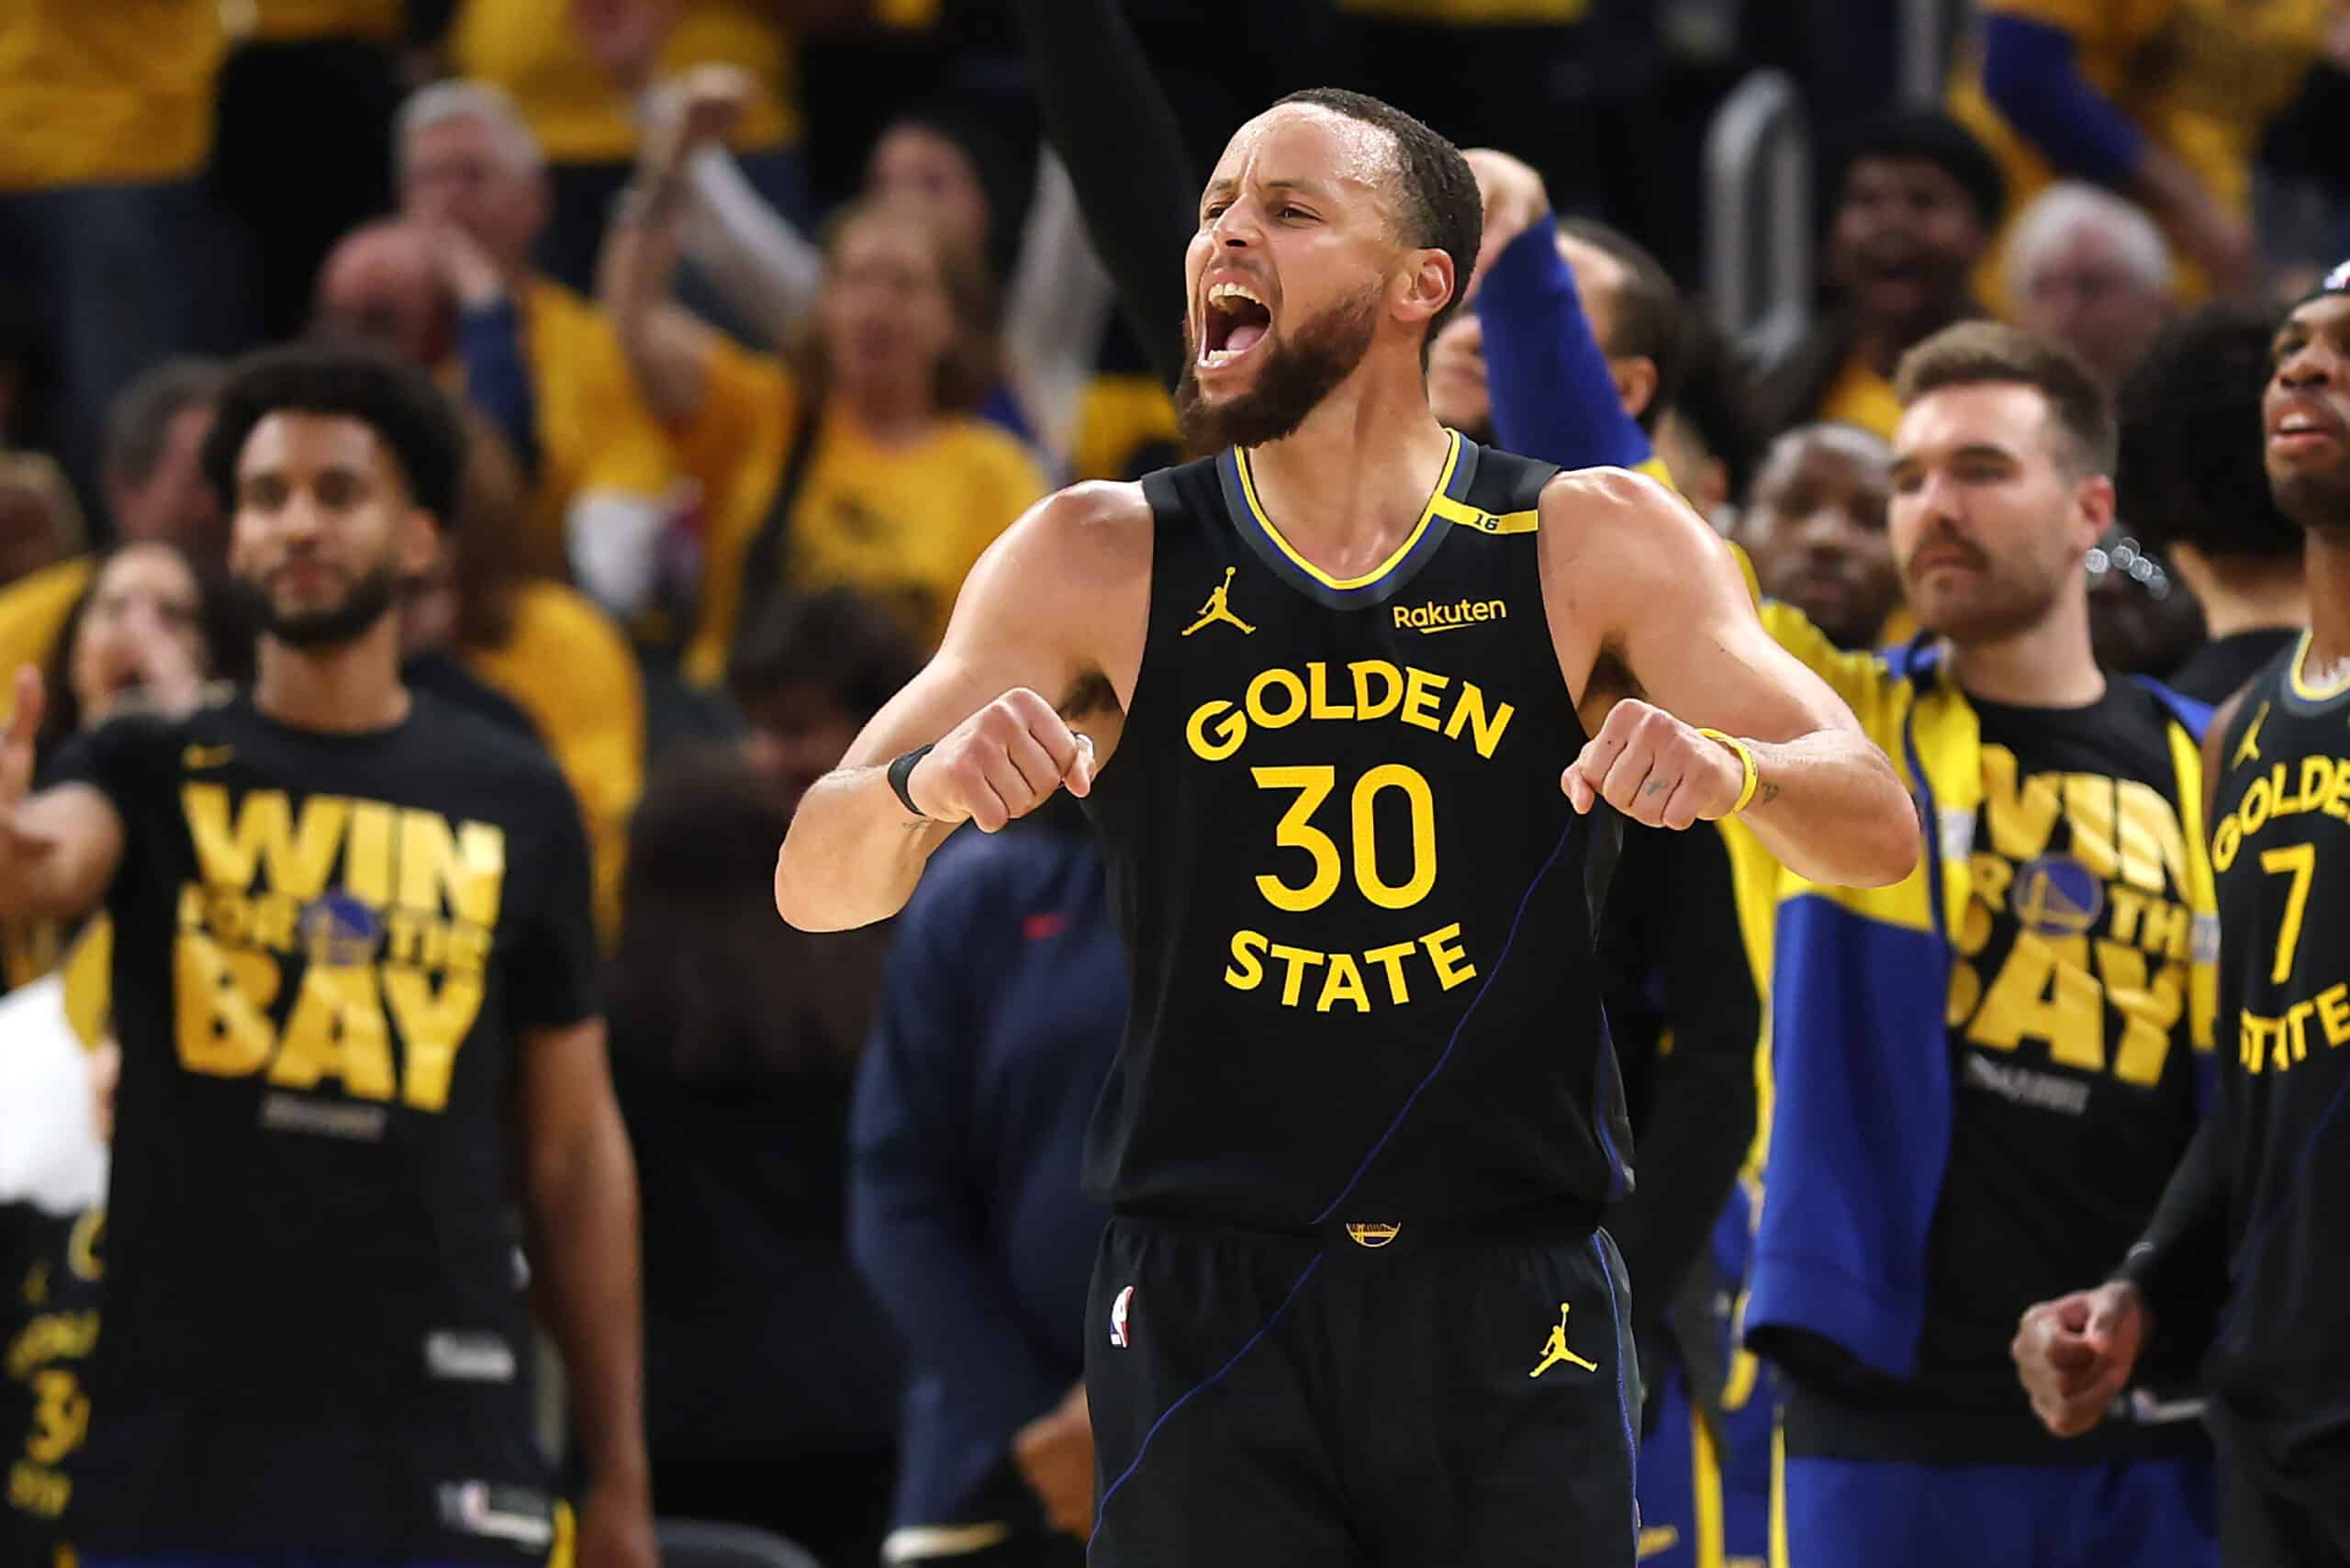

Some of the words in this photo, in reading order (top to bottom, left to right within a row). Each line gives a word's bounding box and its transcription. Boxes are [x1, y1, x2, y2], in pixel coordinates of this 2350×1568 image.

[1474, 514, 1499, 530] 16
[1393, 598, 1506, 631] Rakuten
[1185, 659, 1515, 761] GOLDEN
[181, 783, 506, 927] WIN
[1250, 764, 1437, 912] 30
[2212, 754, 2350, 873] GOLDE
[1224, 922, 1477, 1013] STATE
[2260, 842, 2316, 983] 7
[173, 932, 487, 1114] BAY
